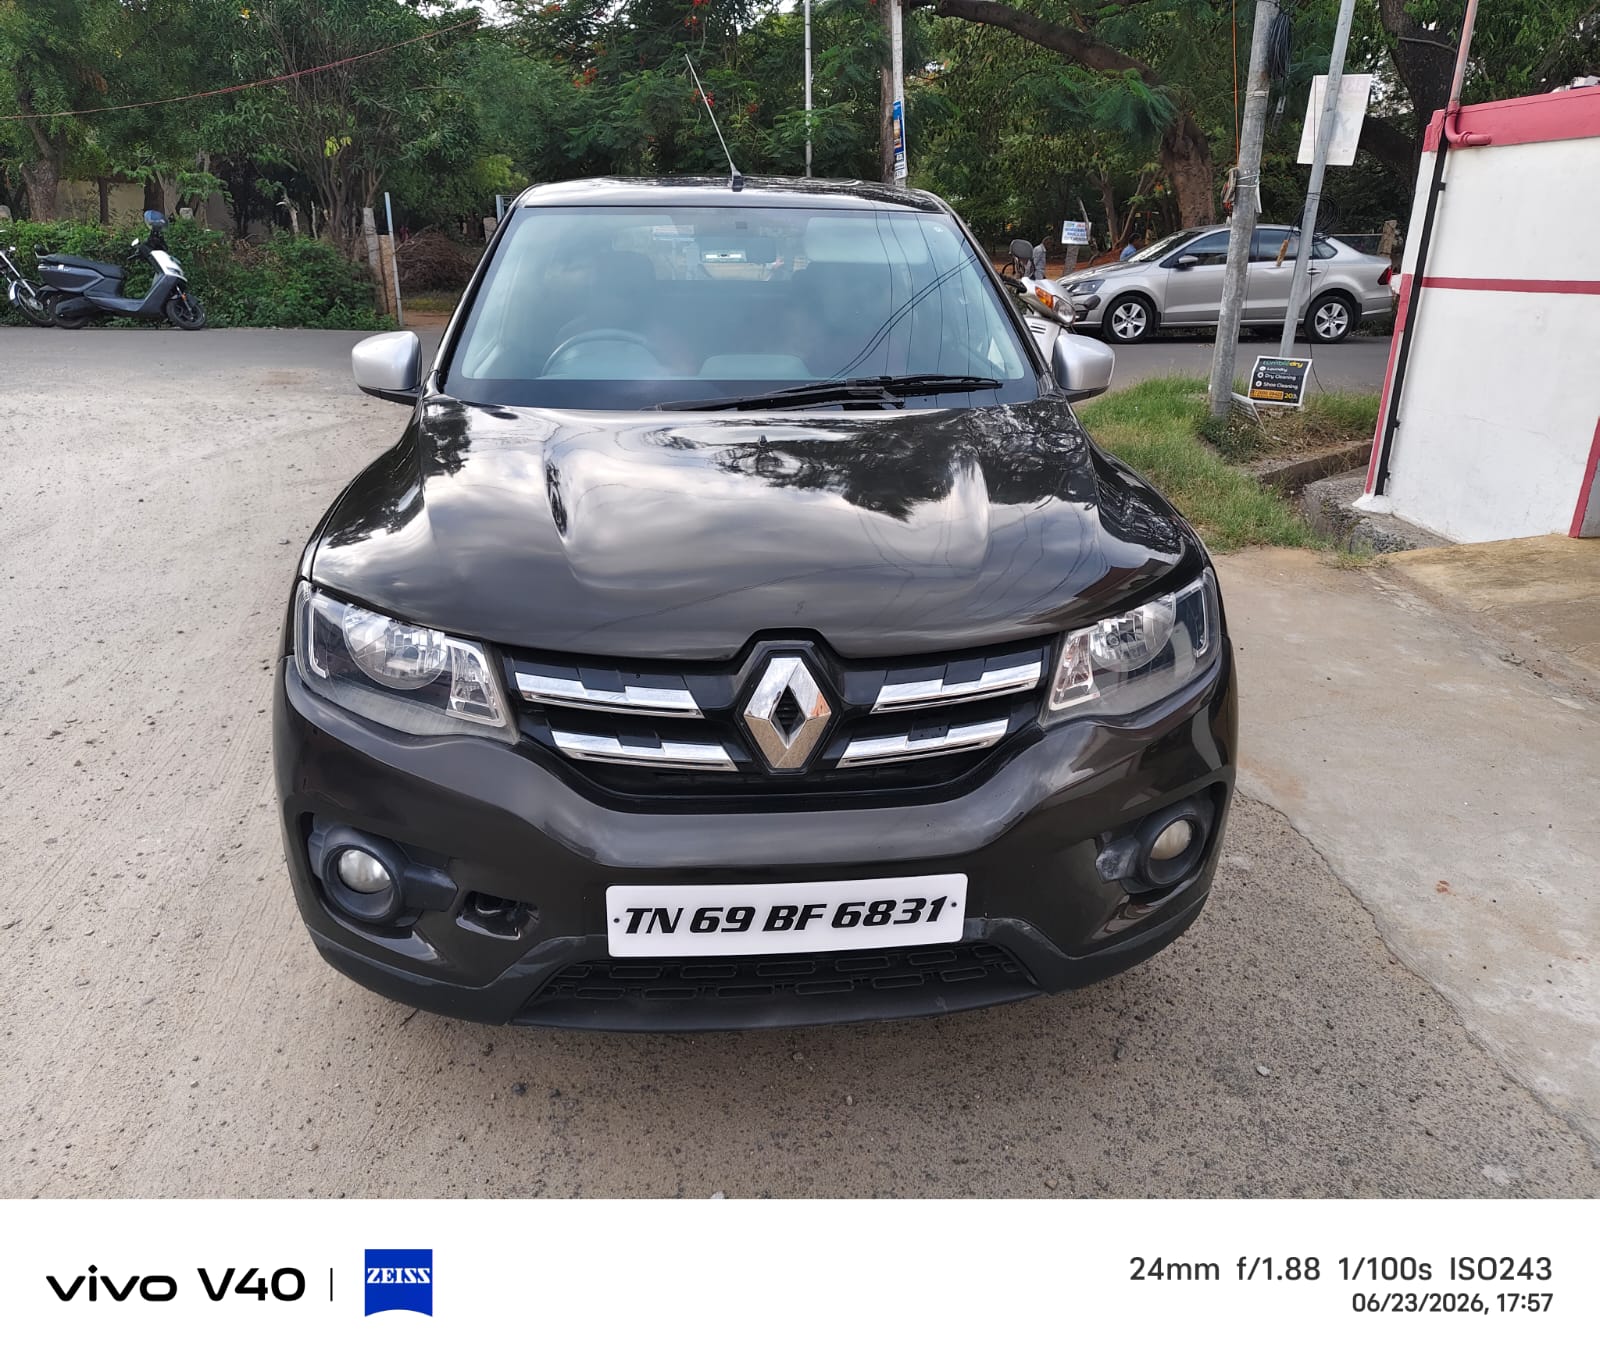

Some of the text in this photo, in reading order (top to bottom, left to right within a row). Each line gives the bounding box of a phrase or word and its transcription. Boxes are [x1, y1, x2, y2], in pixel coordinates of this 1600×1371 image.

[1277, 382, 1298, 390] Cleaning
[626, 895, 948, 934] TN 69 BF 6831
